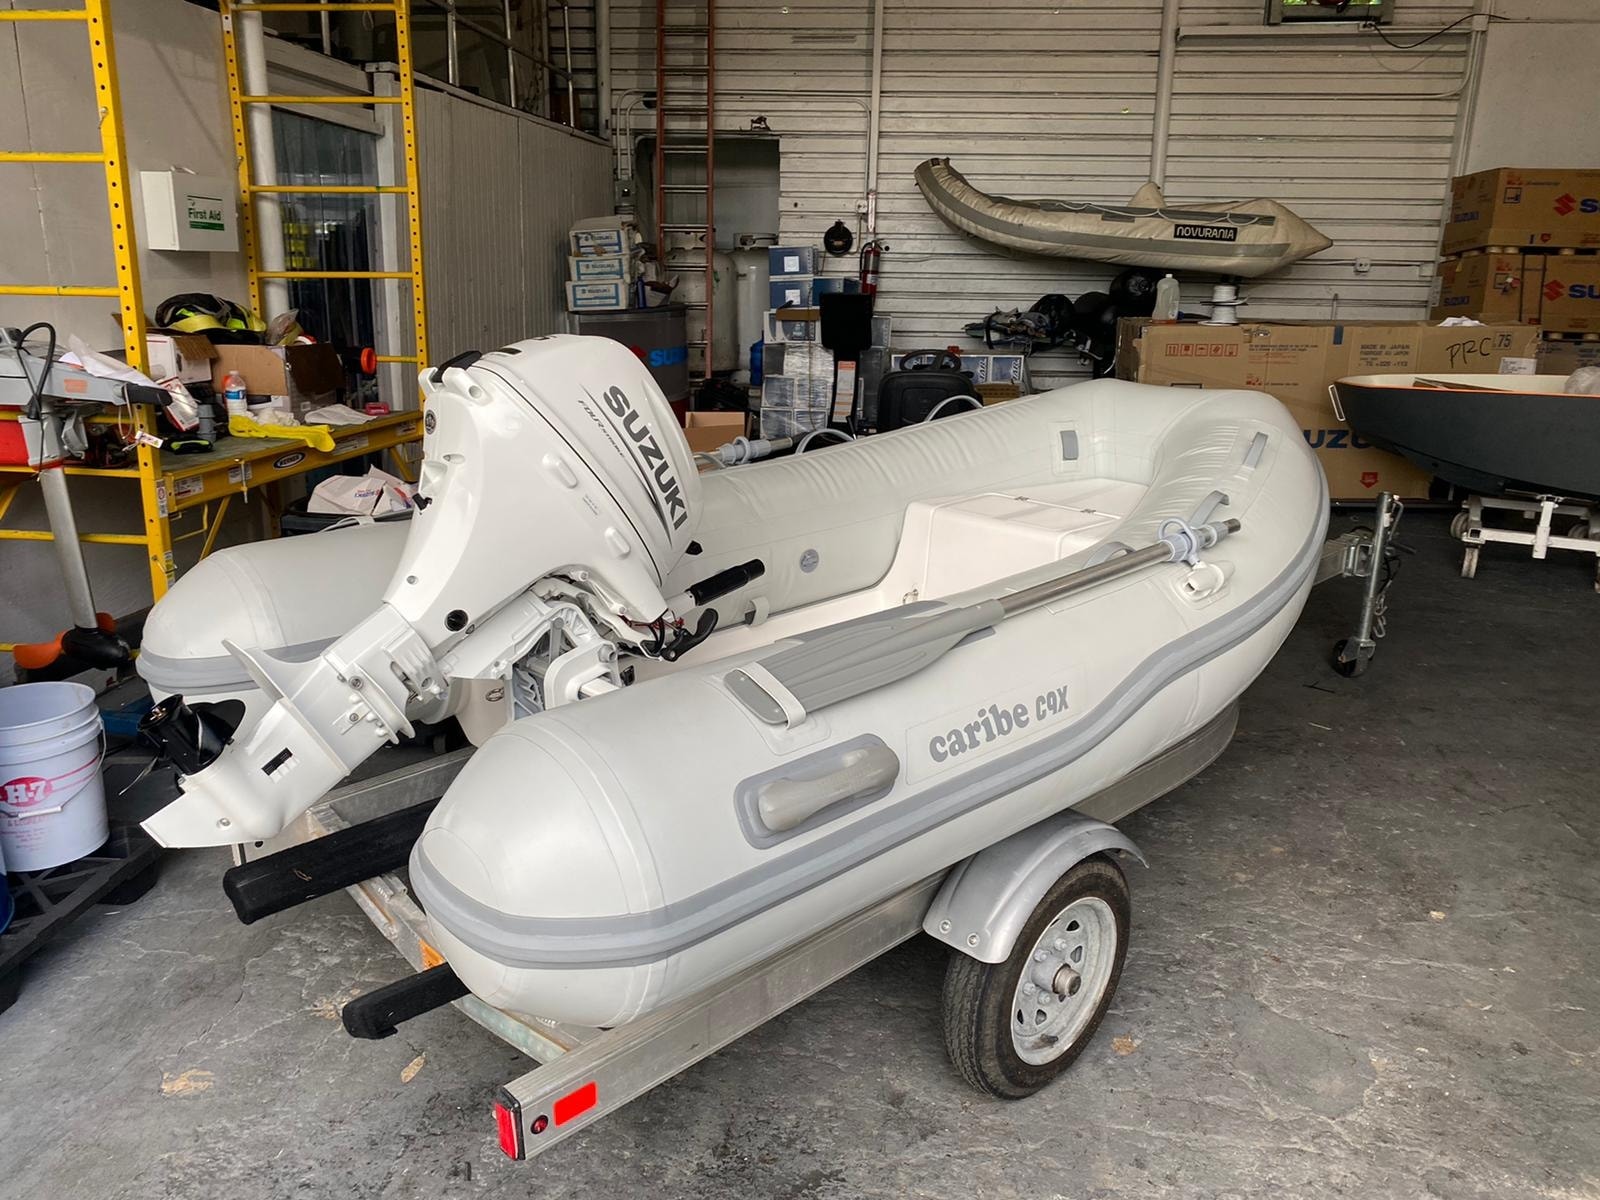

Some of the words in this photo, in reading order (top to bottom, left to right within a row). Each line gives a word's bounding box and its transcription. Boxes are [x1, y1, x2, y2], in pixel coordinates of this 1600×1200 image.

[188, 207, 207, 219] First
[209, 210, 222, 221] Aid
[1176, 226, 1235, 240] NOVURANIA
[1498, 333, 1512, 348] 75
[603, 386, 689, 531] SUZUKI
[929, 704, 1030, 763] caribe
